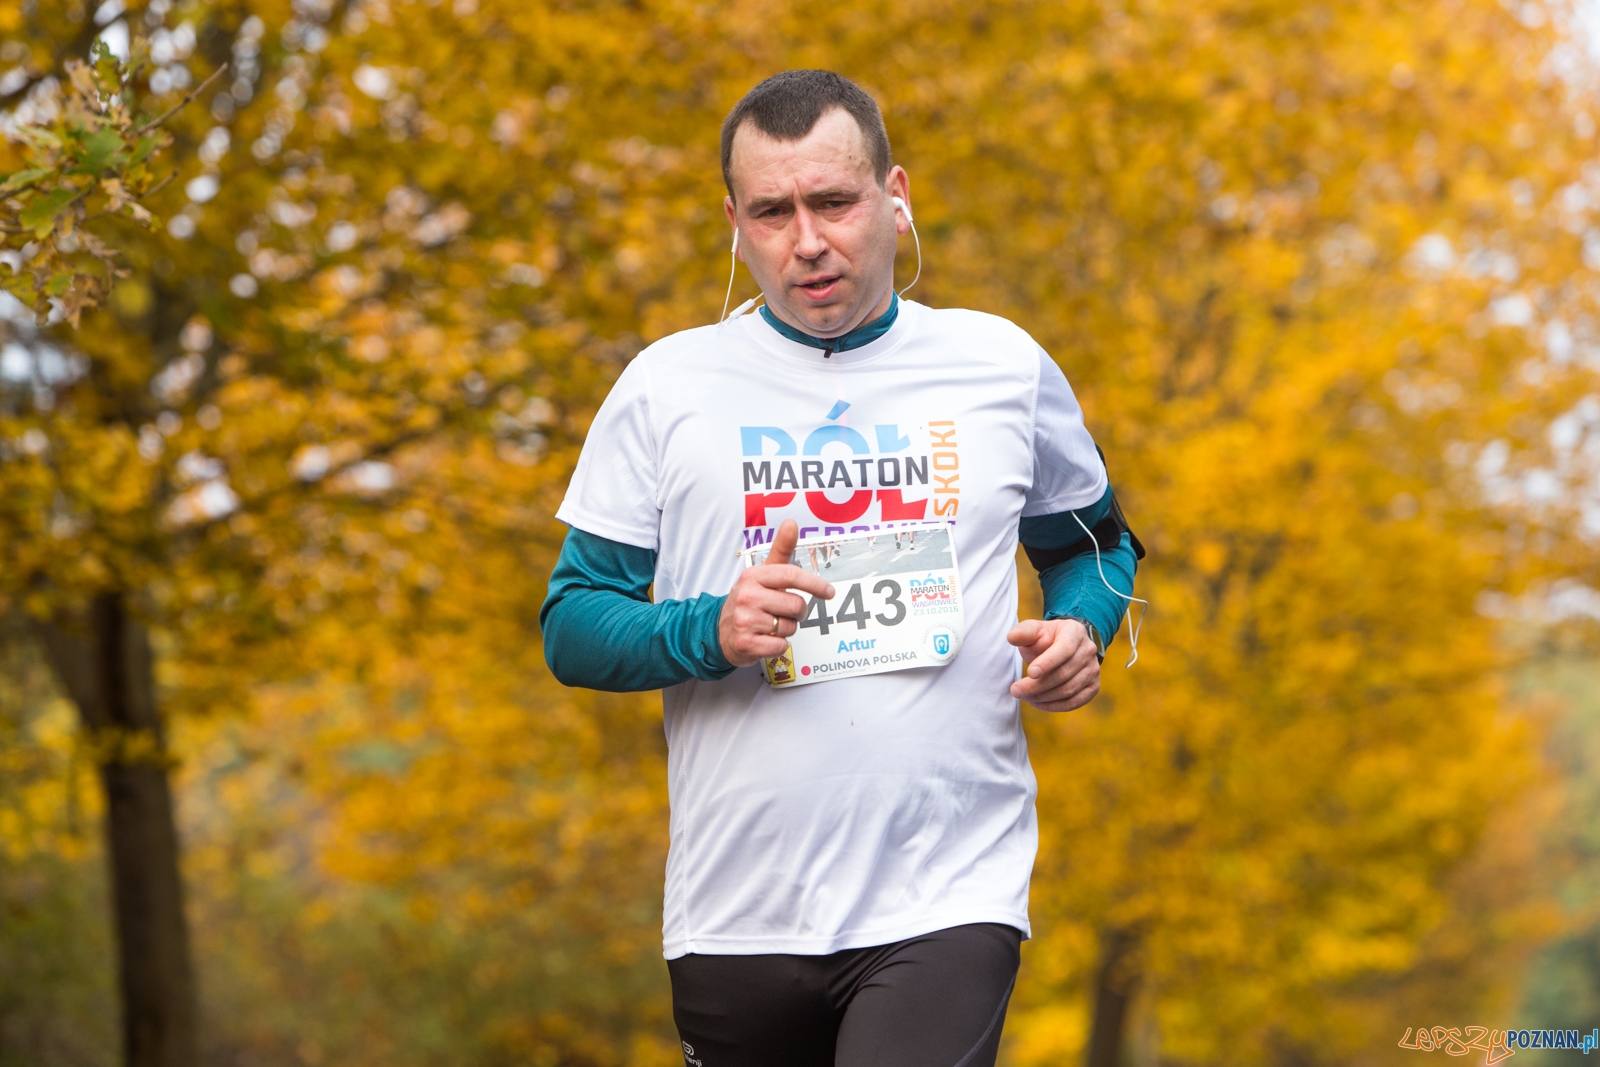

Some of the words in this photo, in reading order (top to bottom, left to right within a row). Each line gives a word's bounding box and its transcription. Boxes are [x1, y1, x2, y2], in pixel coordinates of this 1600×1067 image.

[742, 455, 929, 492] MARATON
[928, 420, 960, 517] SKOKI
[910, 584, 950, 594] MARATON
[913, 605, 959, 616] 23.10.2016
[837, 637, 877, 654] Artur
[812, 657, 871, 674] POLINOVA
[873, 651, 917, 666] POLSKA
